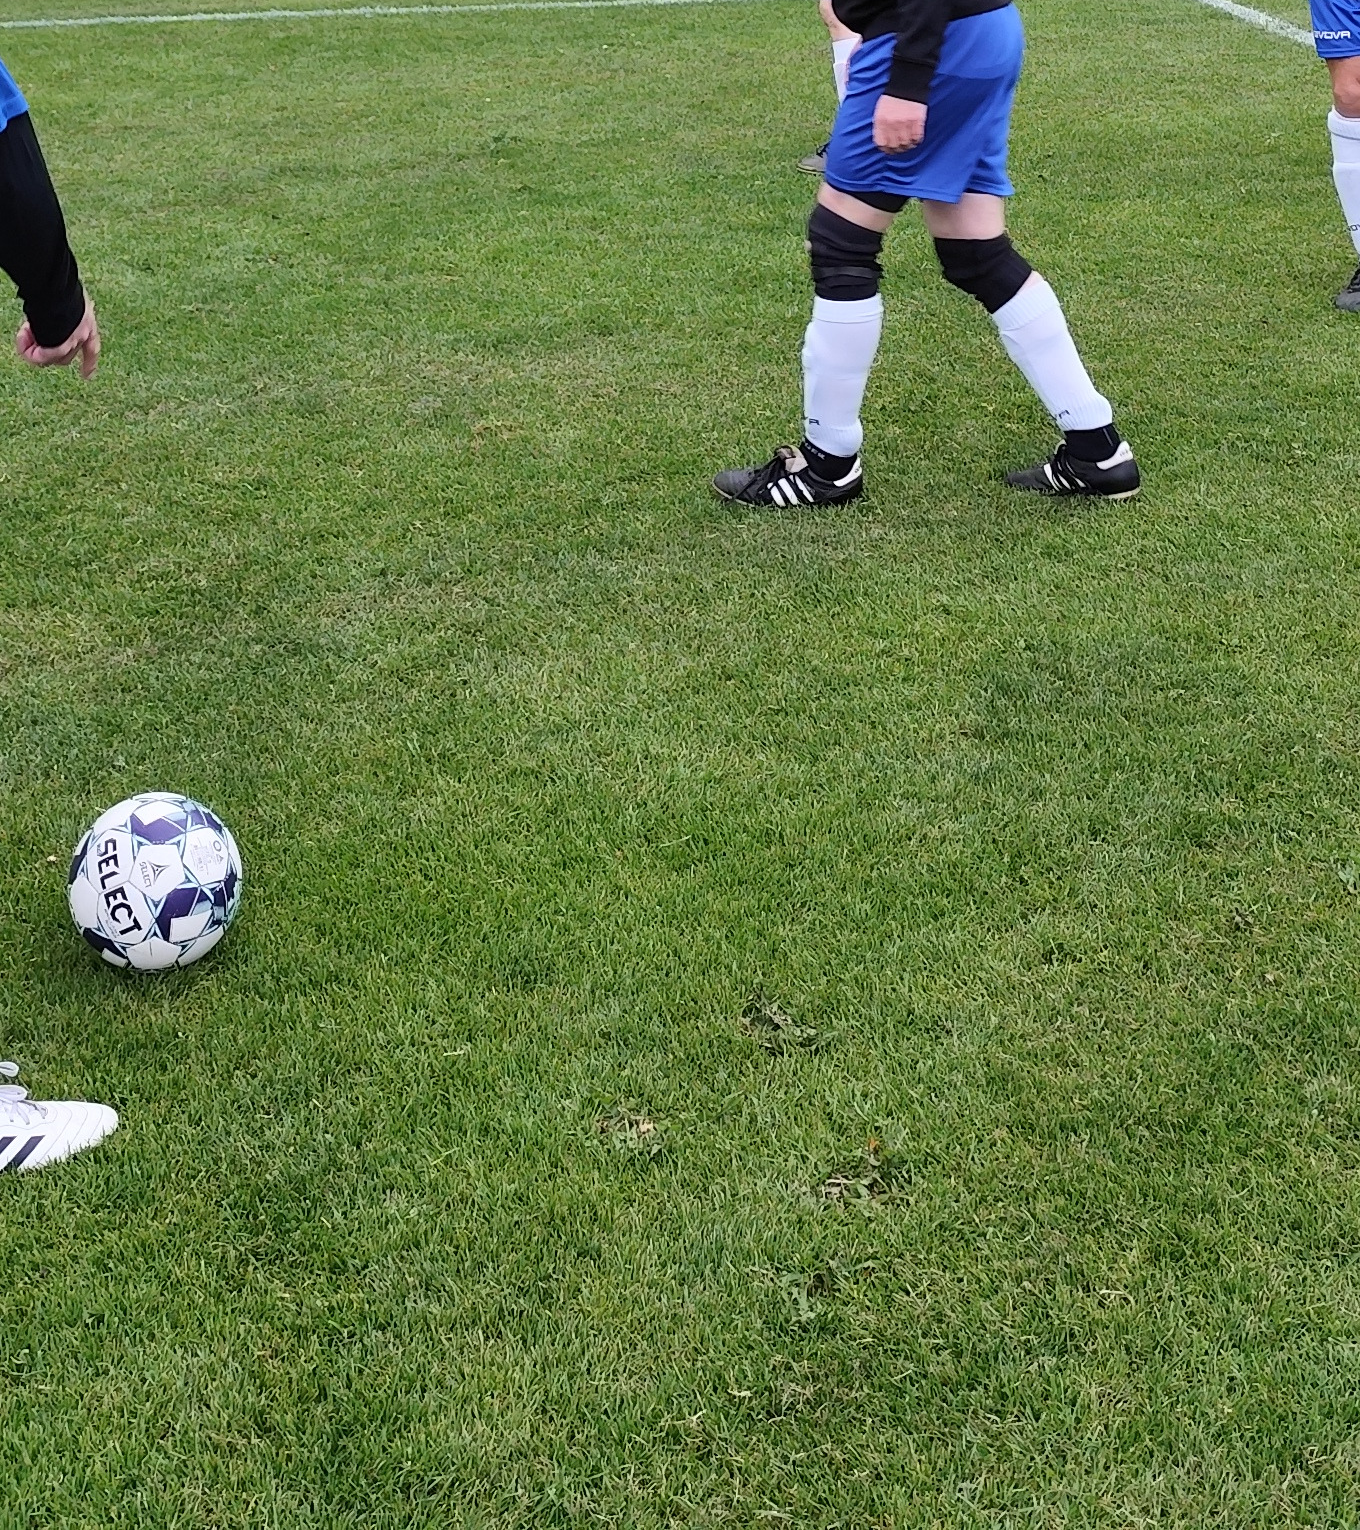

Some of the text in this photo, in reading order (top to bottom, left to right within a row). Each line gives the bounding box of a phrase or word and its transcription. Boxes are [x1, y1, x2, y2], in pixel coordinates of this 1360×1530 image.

[1314, 30, 1351, 40] IVOVA
[97, 838, 142, 936] SELECT
[139, 861, 152, 888] SELECT
